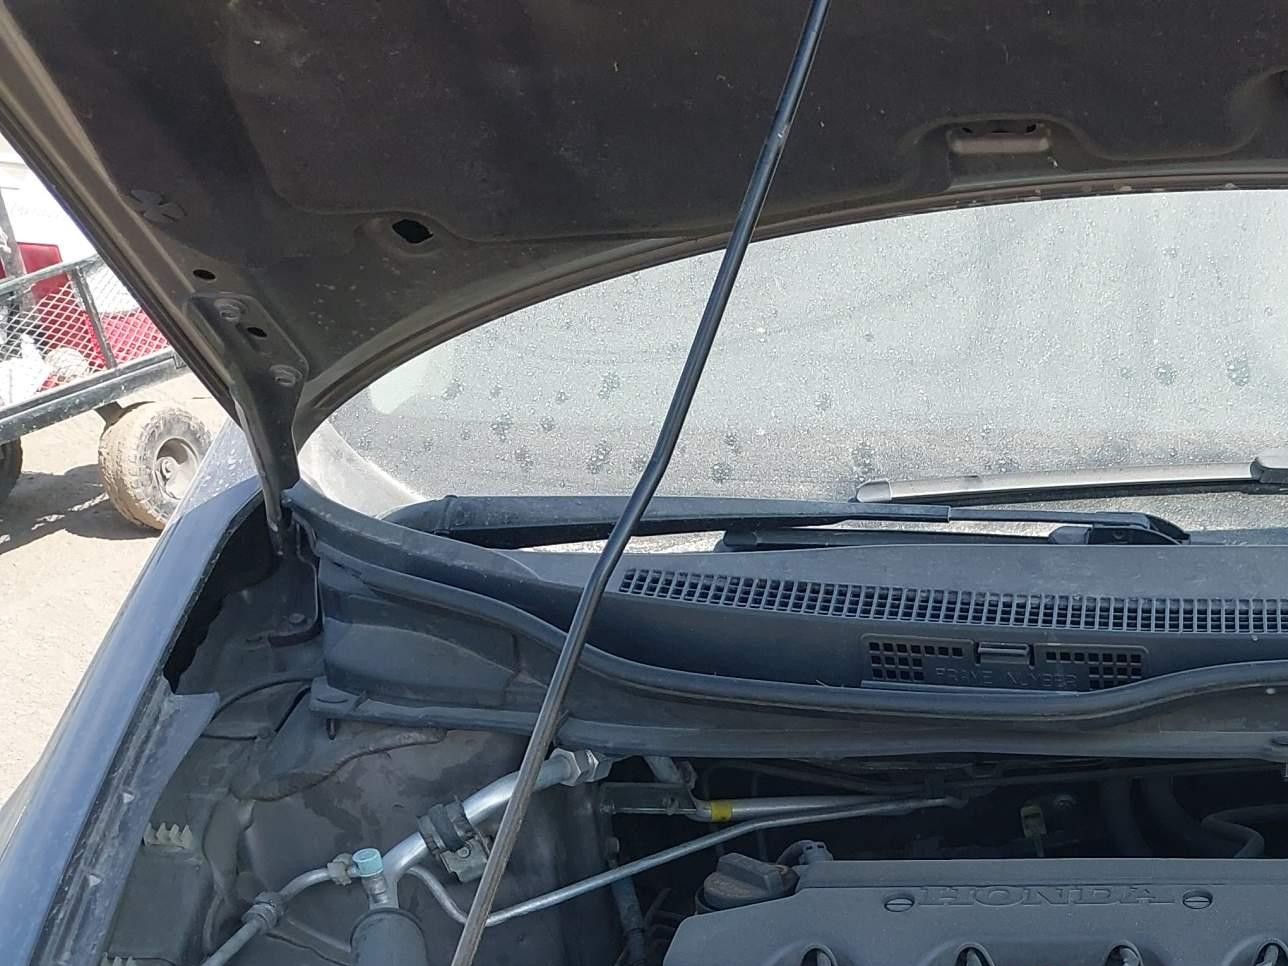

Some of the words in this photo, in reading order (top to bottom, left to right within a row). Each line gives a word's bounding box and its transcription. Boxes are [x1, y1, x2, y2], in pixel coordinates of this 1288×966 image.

[935, 667, 993, 685] FRAME
[1006, 671, 1078, 688] NUMBER
[918, 886, 1177, 906] HONDA
